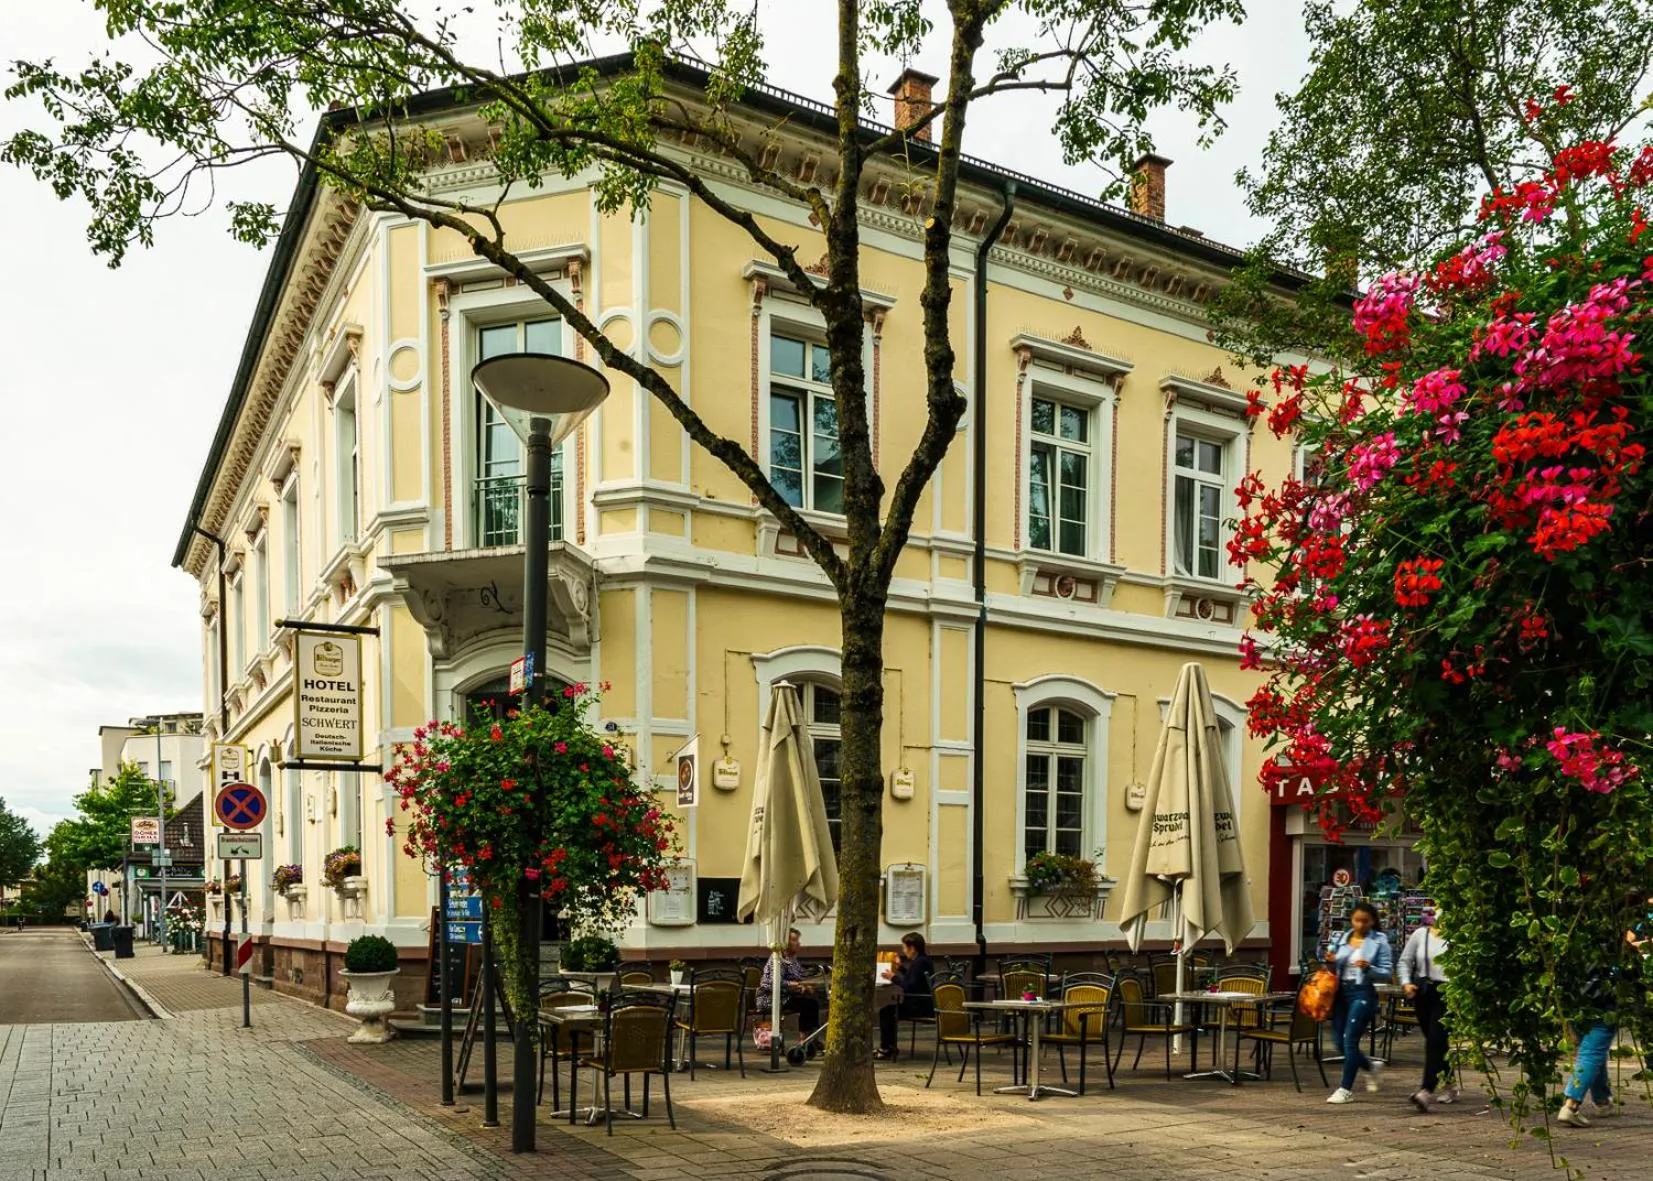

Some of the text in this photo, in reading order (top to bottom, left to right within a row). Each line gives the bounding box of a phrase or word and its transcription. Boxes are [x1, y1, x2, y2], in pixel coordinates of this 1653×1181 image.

[304, 679, 356, 692] HOTEL
[301, 694, 357, 705] Restaurant
[309, 704, 349, 714] Pizzeria
[301, 717, 357, 730] SCHWERT
